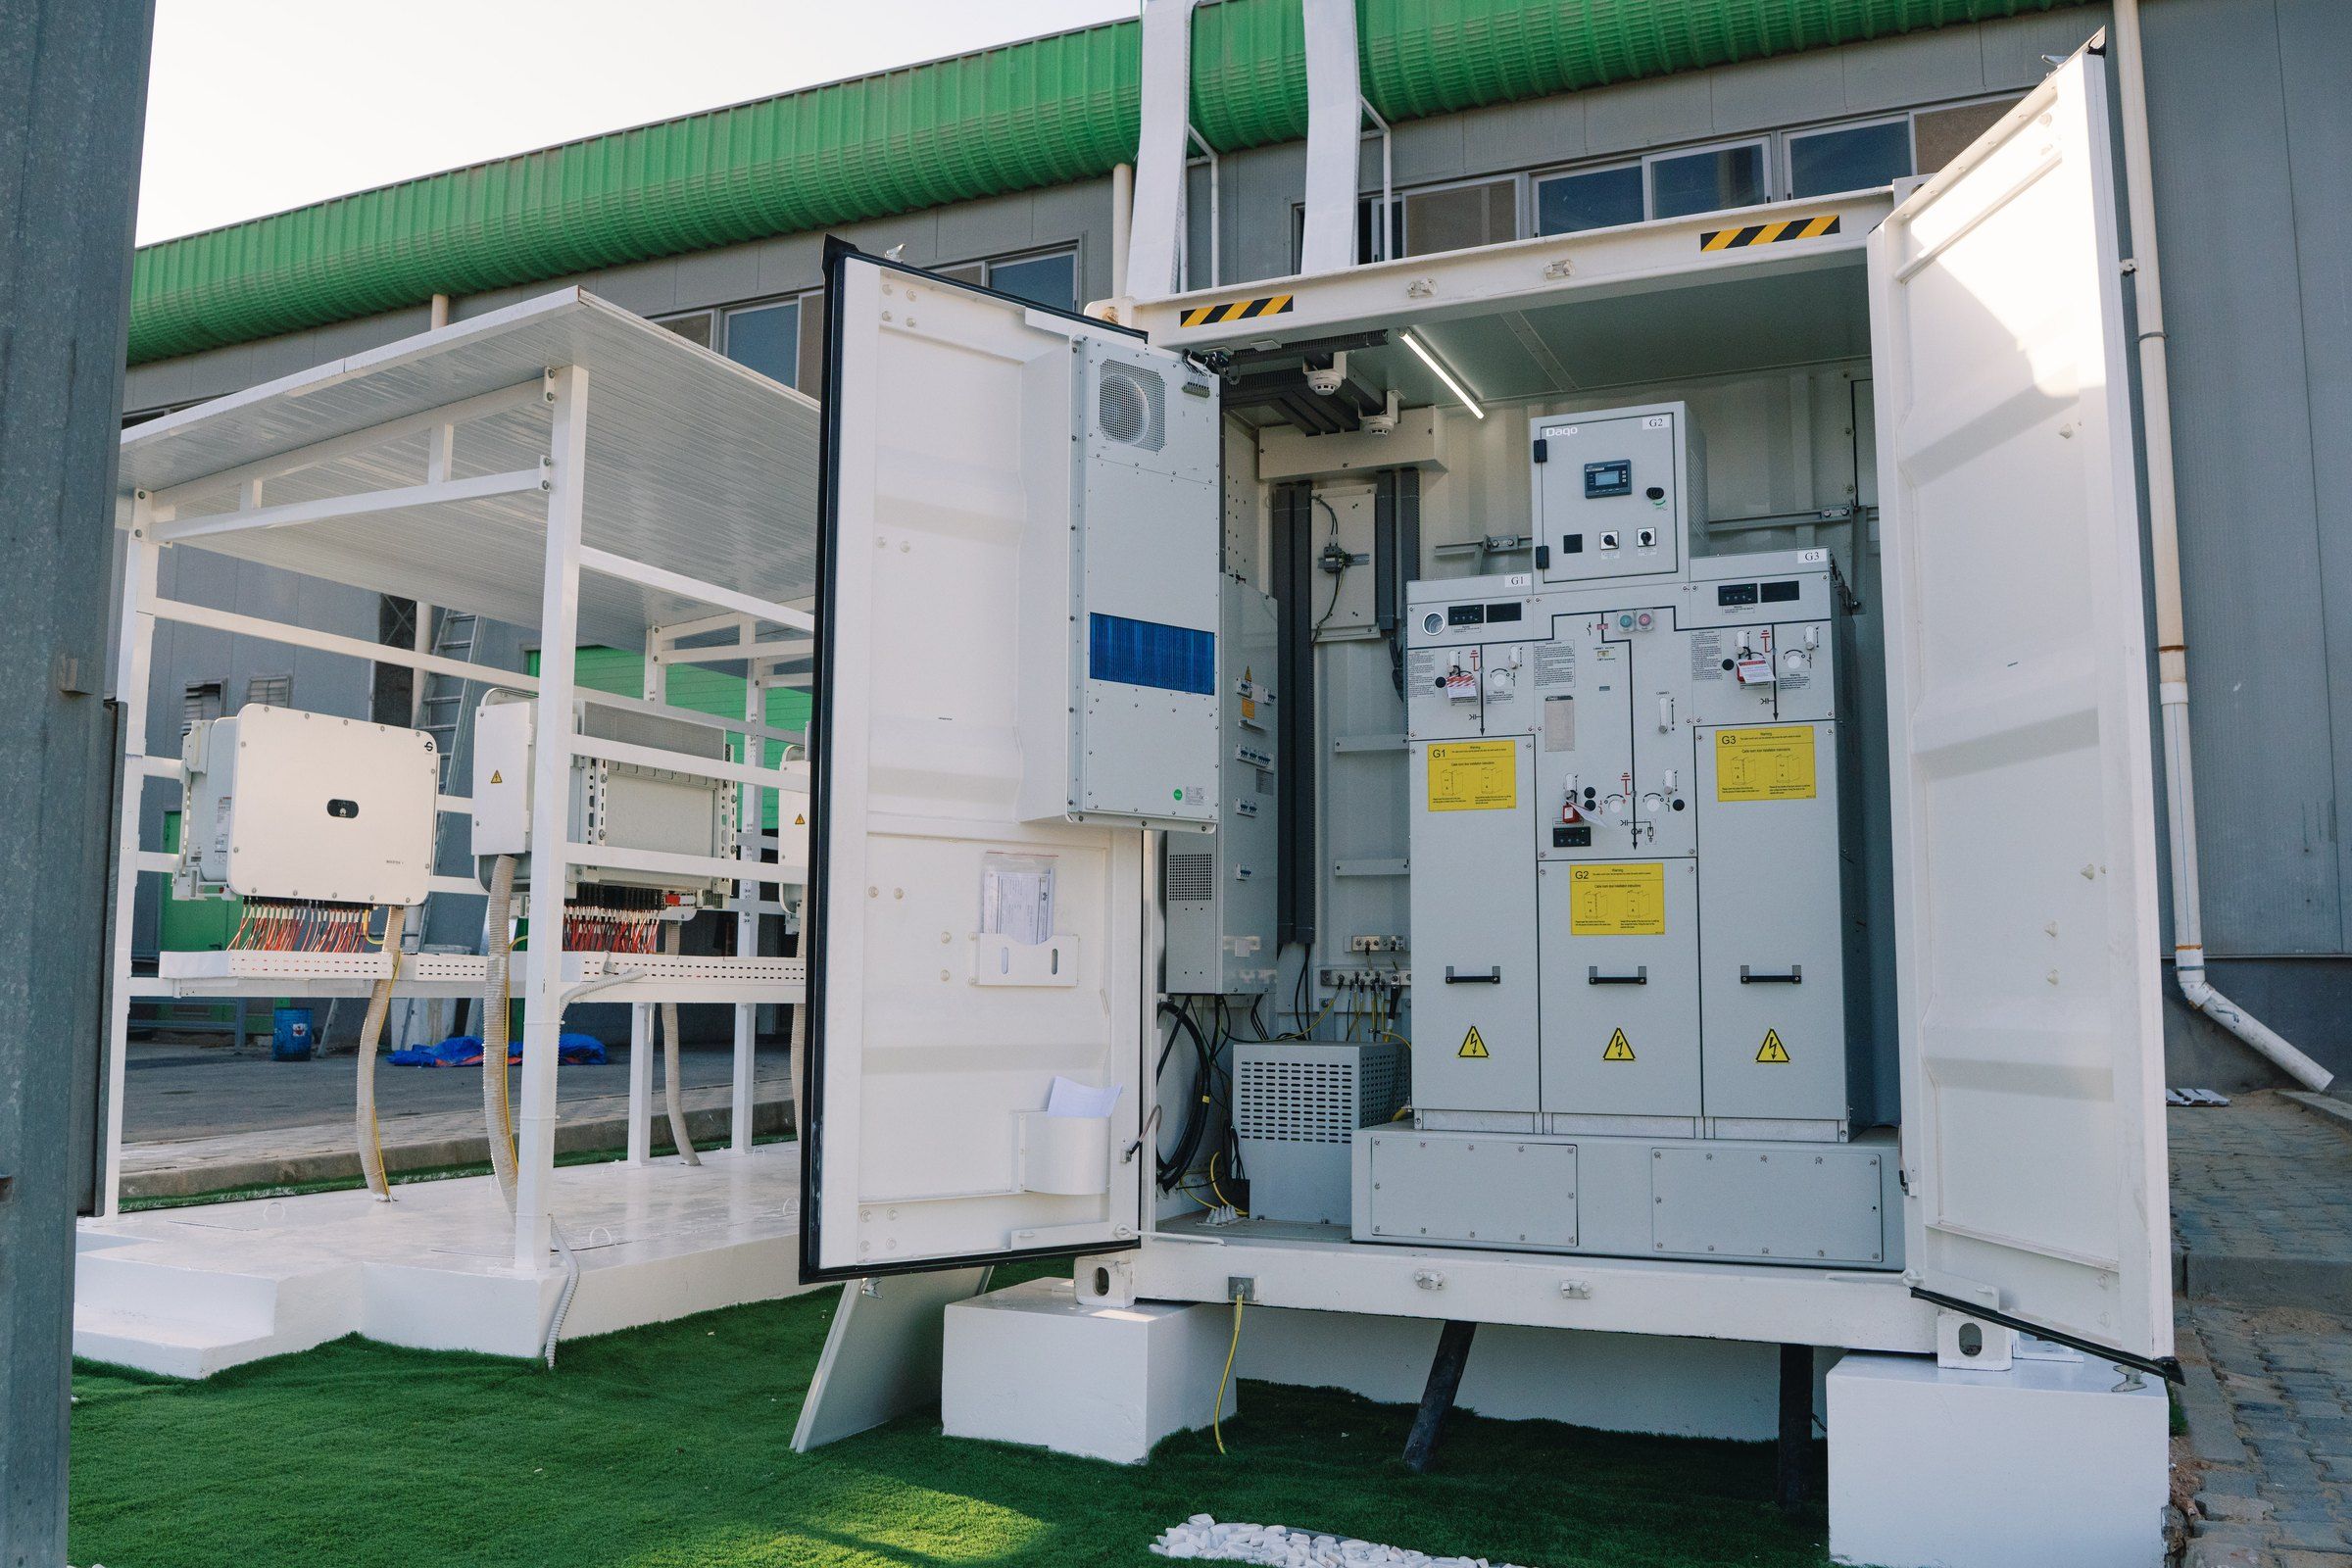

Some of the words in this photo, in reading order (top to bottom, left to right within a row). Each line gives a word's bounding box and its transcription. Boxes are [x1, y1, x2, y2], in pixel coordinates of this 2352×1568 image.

[1648, 417, 1663, 428] G2
[1804, 551, 1820, 562] G3
[1510, 576, 1524, 586] G1
[1721, 735, 1737, 745] G3
[1432, 749, 1446, 759] G1
[1575, 870, 1590, 880] G2
